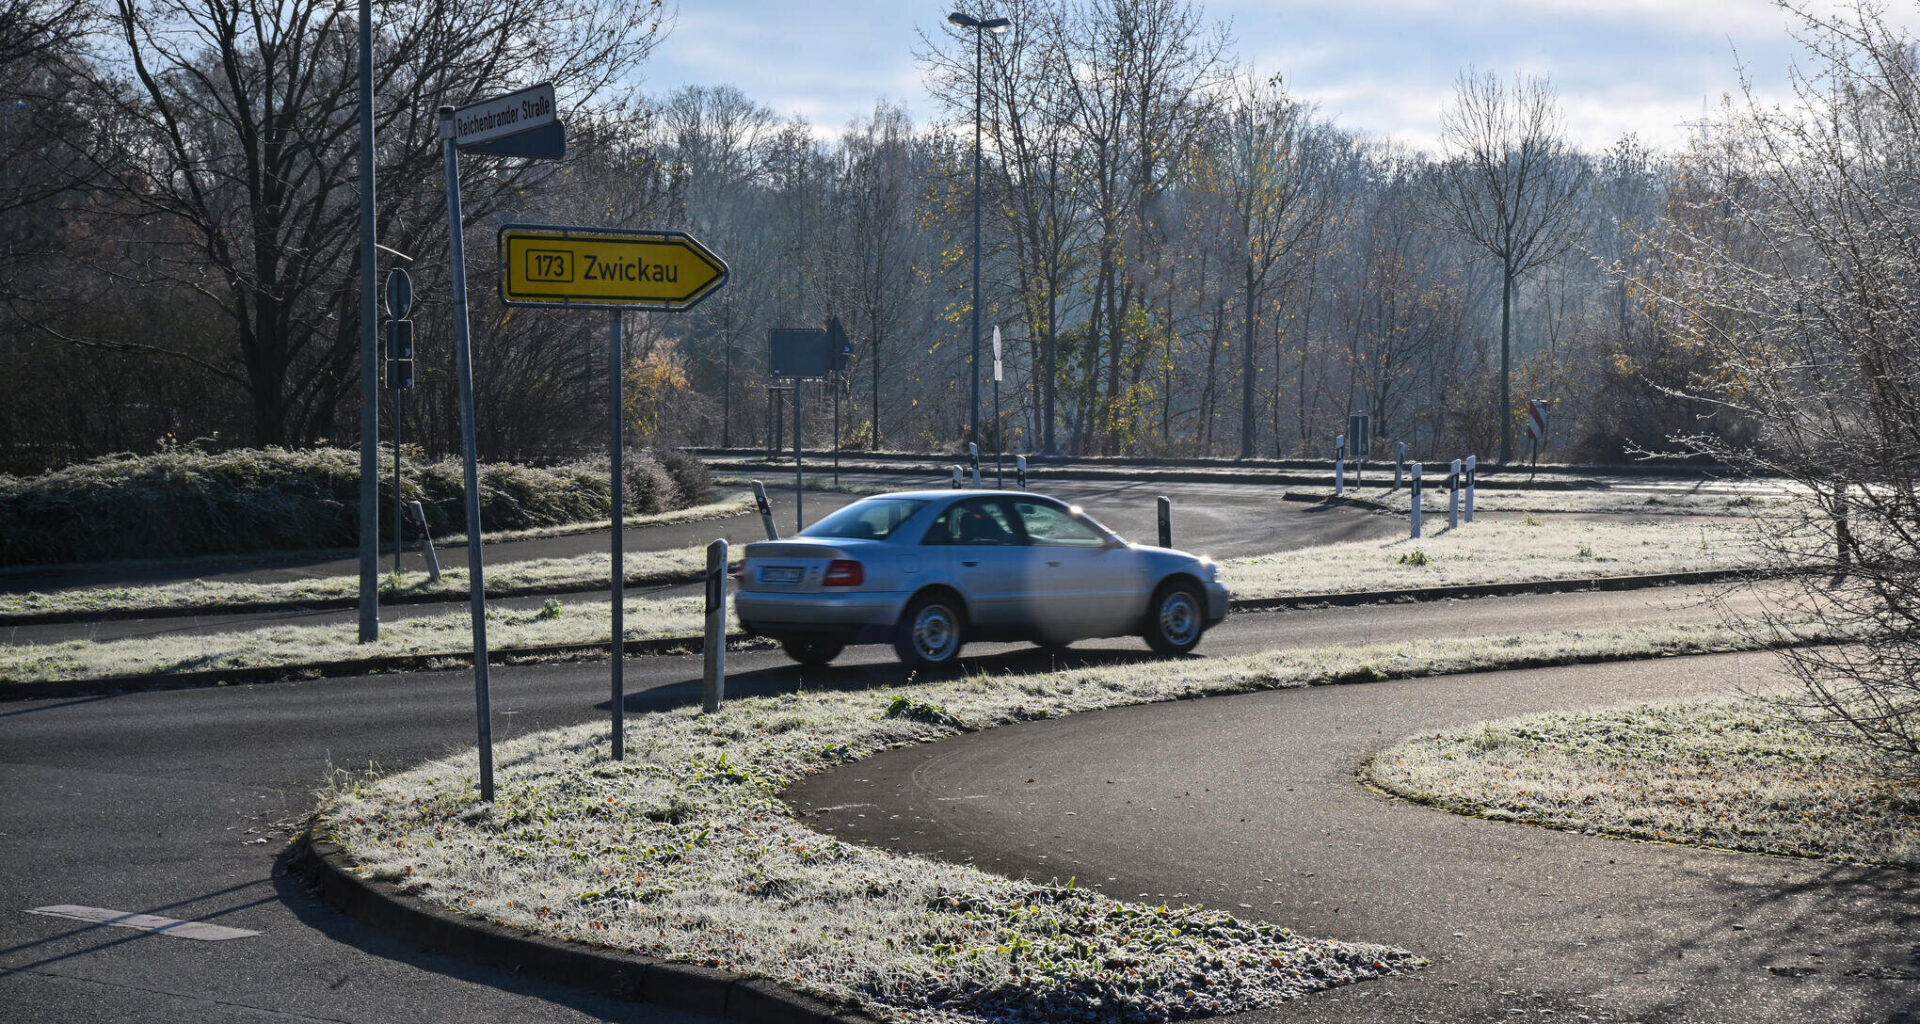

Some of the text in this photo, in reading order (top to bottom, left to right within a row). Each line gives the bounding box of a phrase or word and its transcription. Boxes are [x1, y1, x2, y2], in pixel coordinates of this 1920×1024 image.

[457, 95, 550, 138] Reichenbrander Straße
[535, 254, 678, 283] 173 Zwickau
